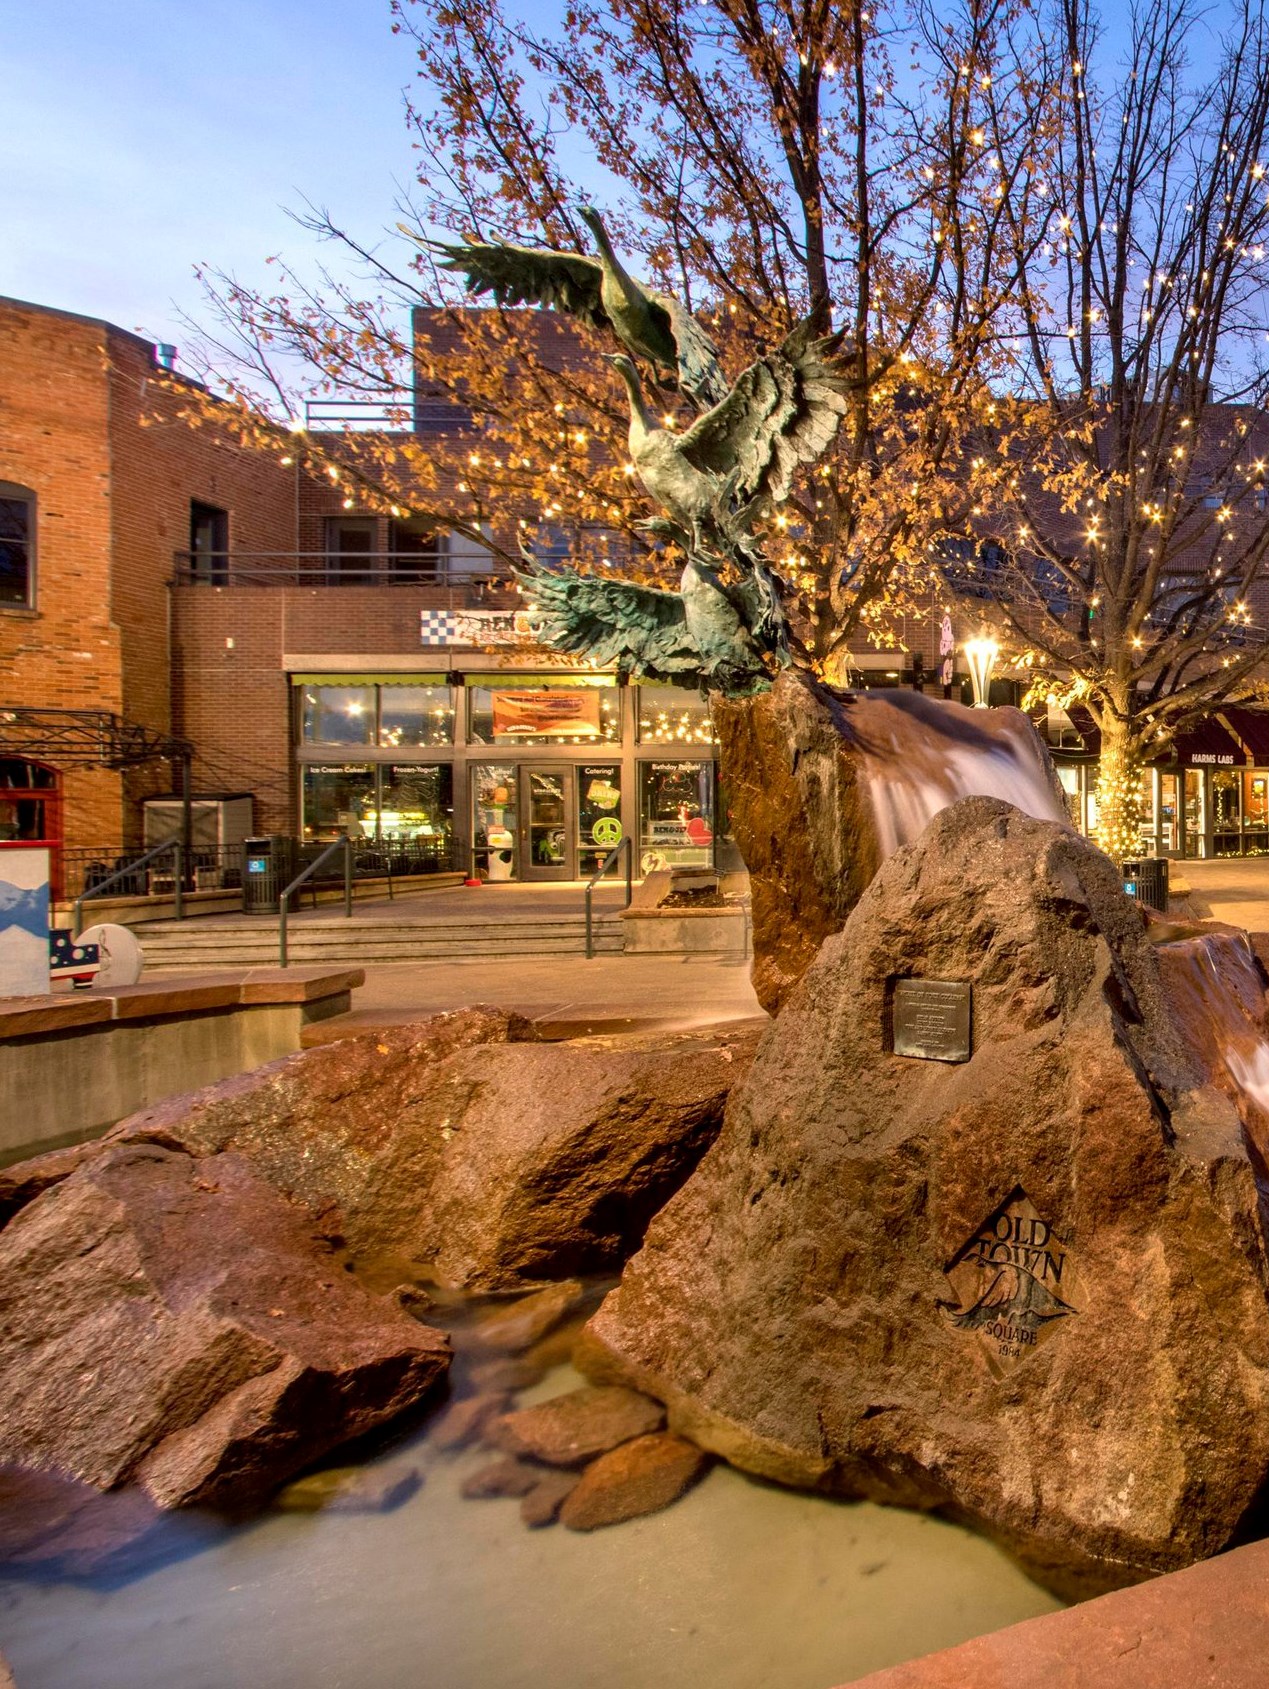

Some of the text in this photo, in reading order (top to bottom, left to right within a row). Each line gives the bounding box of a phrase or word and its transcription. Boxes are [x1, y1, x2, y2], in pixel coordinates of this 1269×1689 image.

[584, 767, 614, 775] Catering!
[1191, 753, 1234, 765] HARMS LABS
[992, 1213, 1051, 1248] OLD
[977, 1238, 1067, 1284] TOWN
[985, 1321, 1038, 1346] SQUARE
